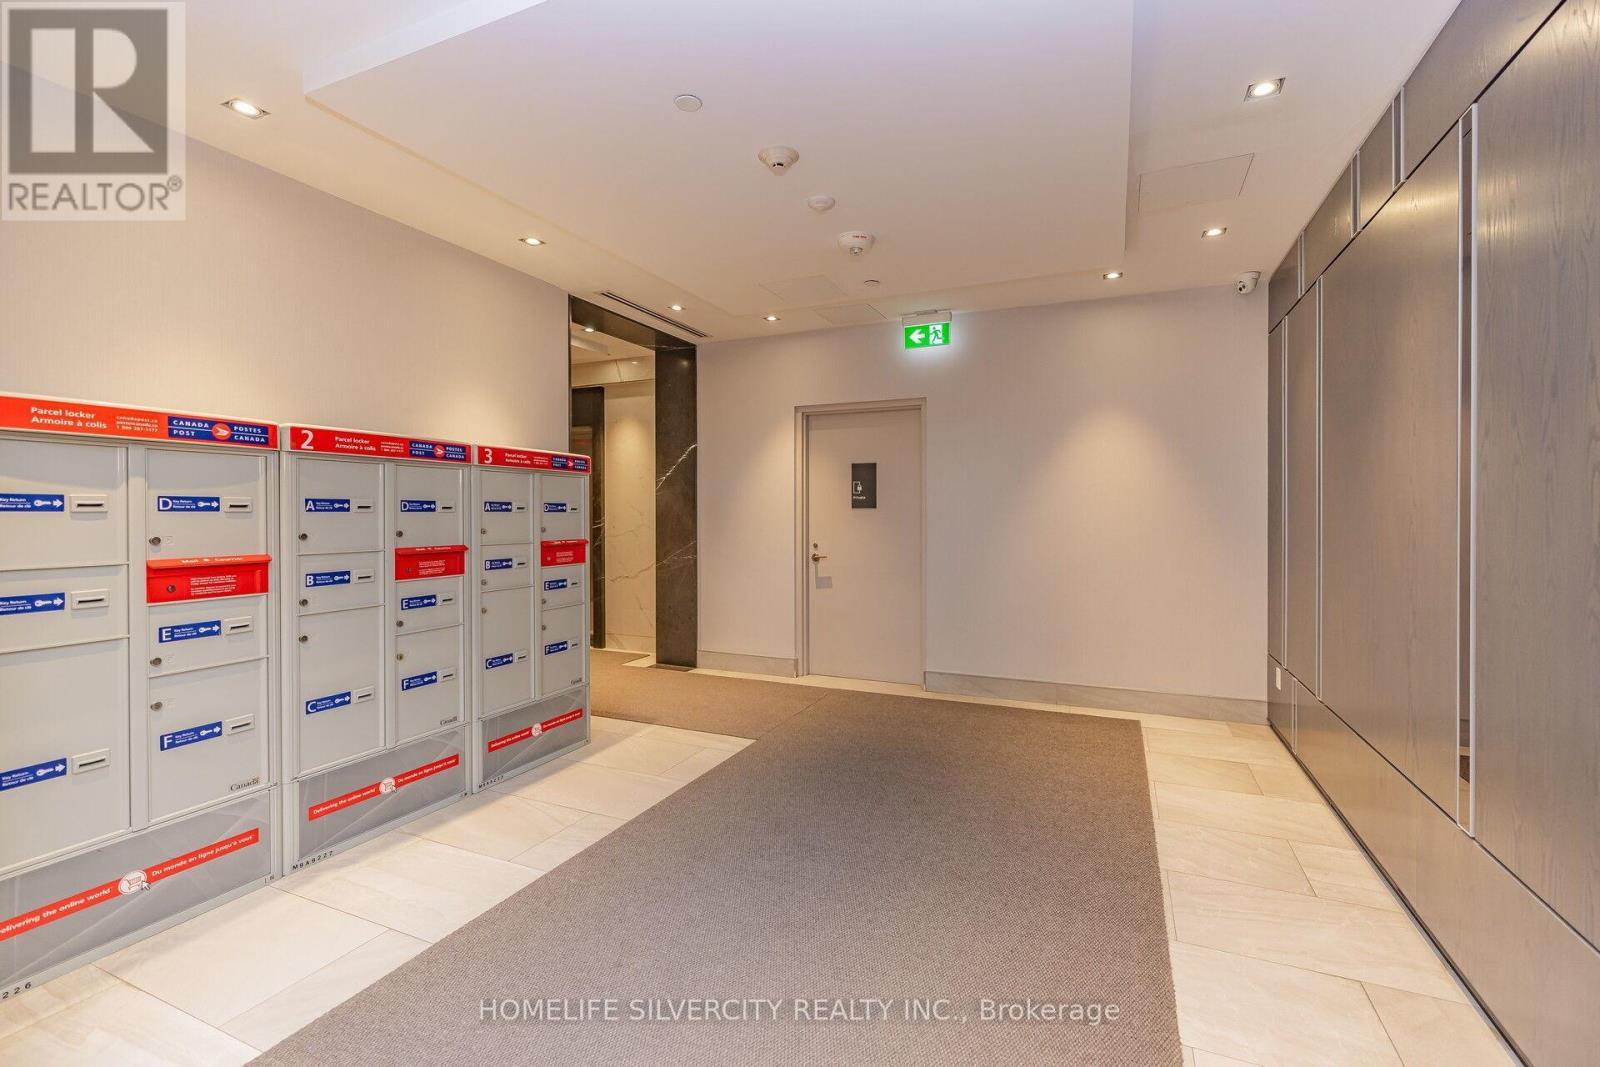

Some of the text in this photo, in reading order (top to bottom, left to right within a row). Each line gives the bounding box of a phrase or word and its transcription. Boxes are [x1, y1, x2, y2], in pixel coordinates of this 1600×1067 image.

[31, 406, 96, 419] Parcel locker
[32, 416, 107, 429] Armoire à colis
[173, 420, 210, 428] CANADA
[300, 430, 314, 450] 2
[484, 448, 493, 464] 3
[160, 498, 172, 510] D
[306, 500, 314, 510] A
[402, 502, 408, 510] D
[485, 503, 490, 511] A
[486, 560, 490, 569] B
[306, 575, 314, 586] B
[403, 600, 408, 609] E
[162, 628, 172, 640] E
[487, 659, 492, 668] C
[404, 680, 409, 689] F
[308, 701, 316, 712] C
[164, 735, 173, 748] F
[230, 776, 260, 792] Canada
[152, 869, 162, 877] Du
[163, 860, 187, 873] monde
[199, 850, 214, 860] ligne
[239, 835, 253, 844] vous
[0, 888, 110, 934] elivering the online world
